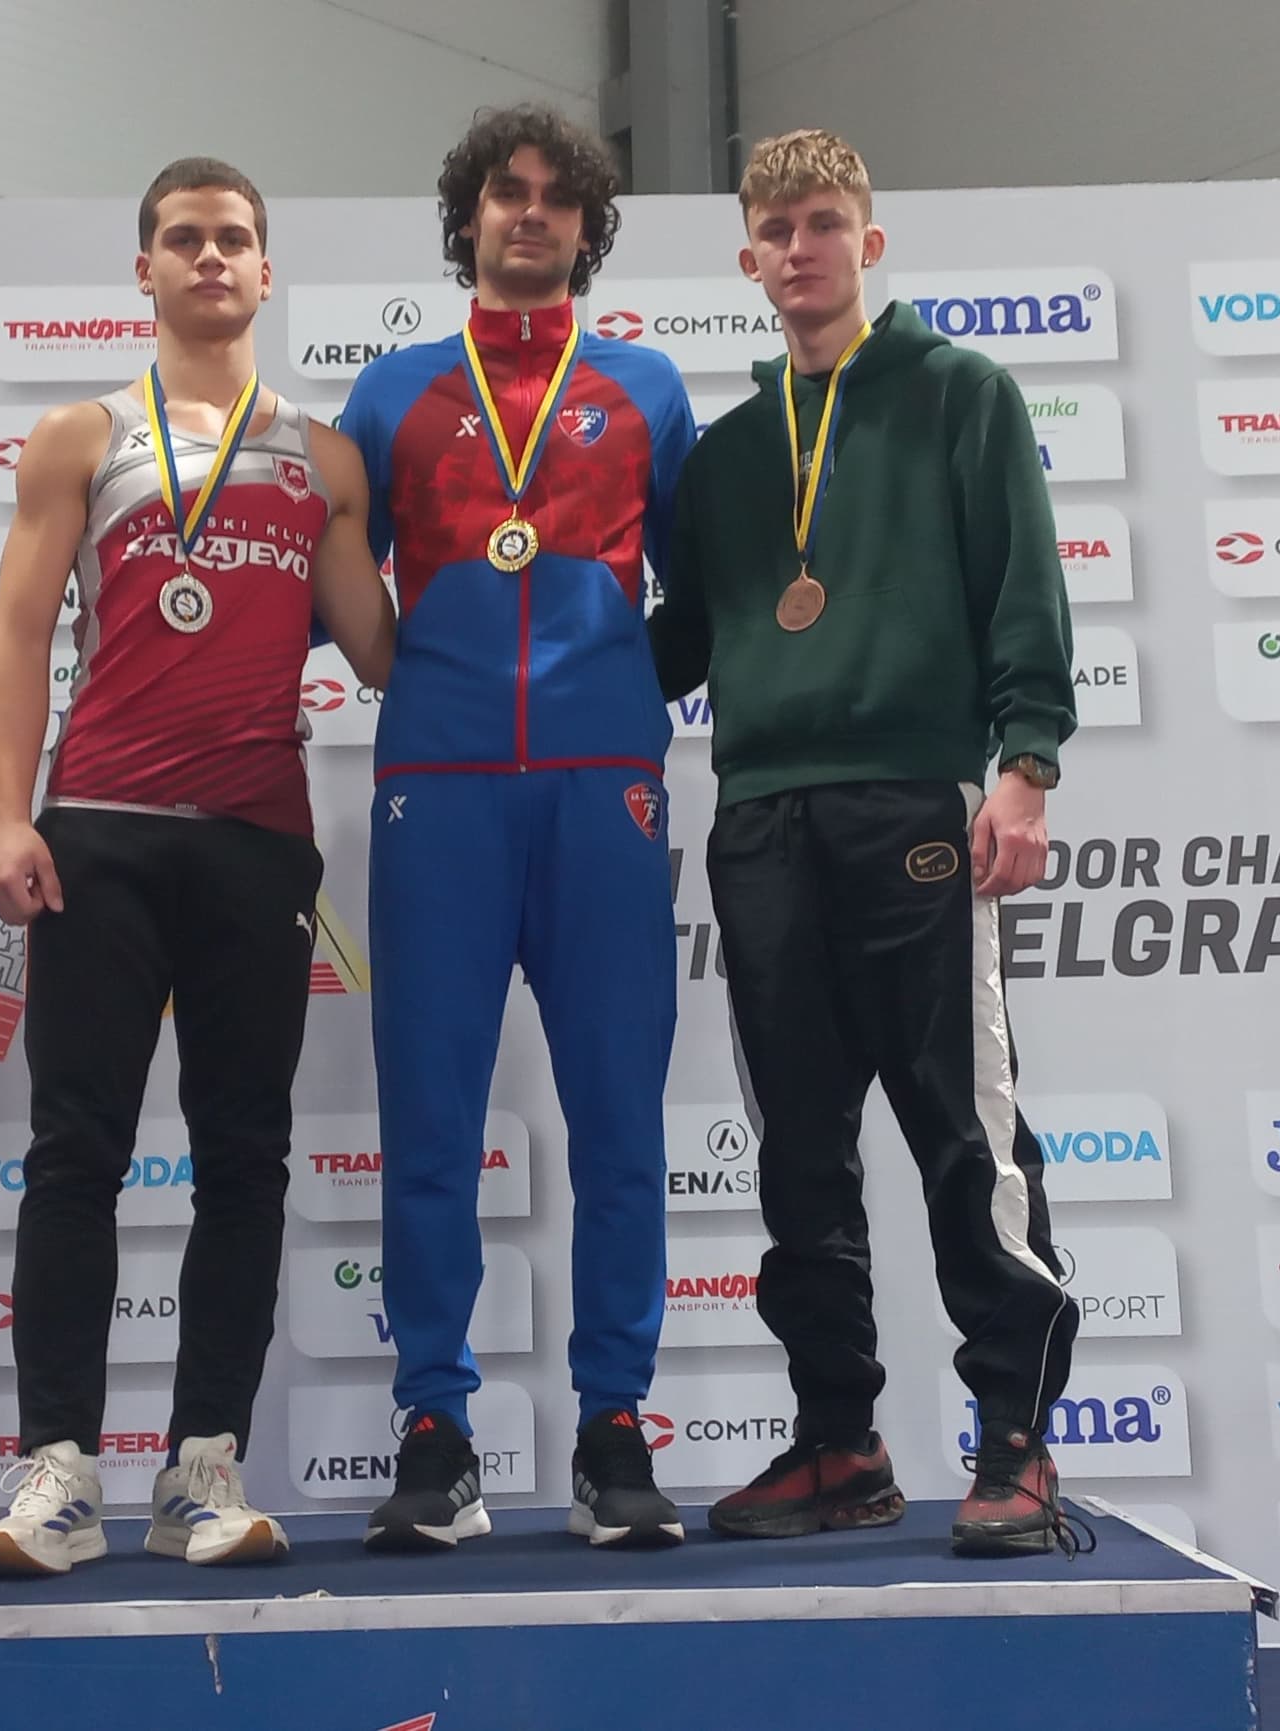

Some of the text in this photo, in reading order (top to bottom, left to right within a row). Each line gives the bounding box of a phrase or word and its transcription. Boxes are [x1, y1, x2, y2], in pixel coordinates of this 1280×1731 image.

[3, 317, 158, 343] TRANSFE
[127, 514, 247, 533] ATLSKI
[685, 1417, 795, 1441] COMTR
